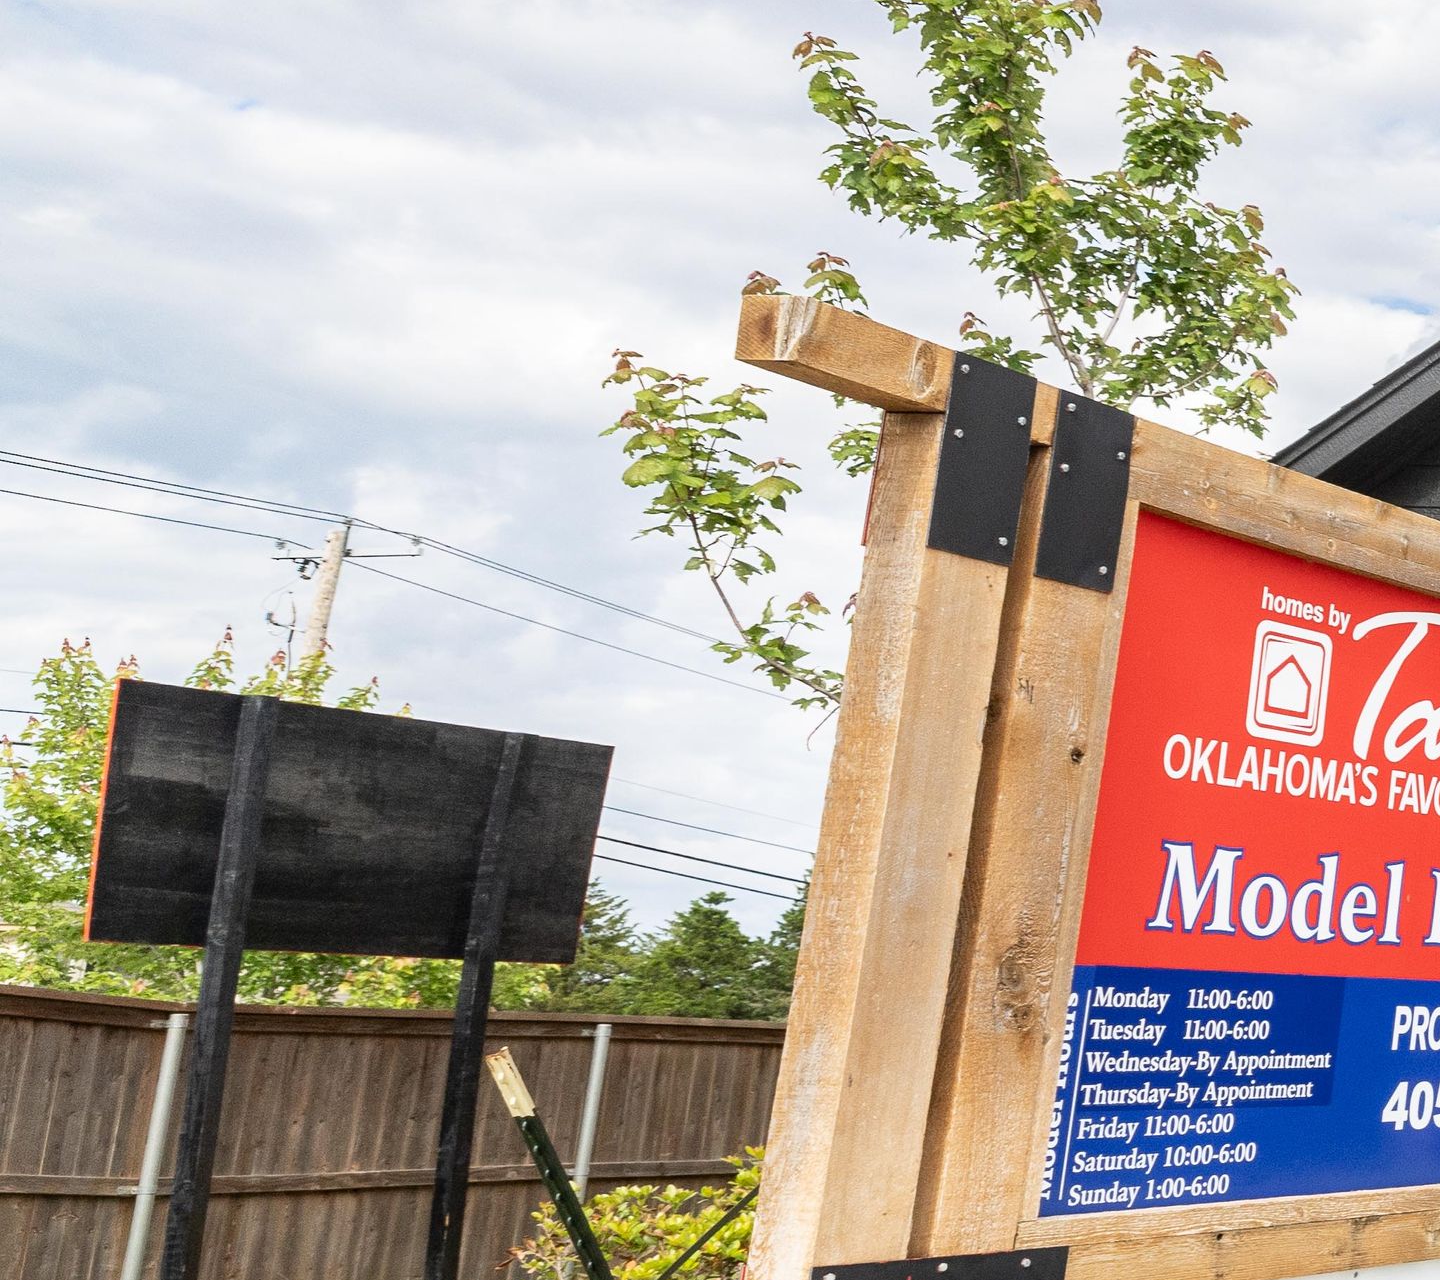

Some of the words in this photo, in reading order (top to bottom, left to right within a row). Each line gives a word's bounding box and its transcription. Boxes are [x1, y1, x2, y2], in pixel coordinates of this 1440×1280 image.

[1261, 586, 1324, 624] homes
[1328, 602, 1351, 634] by
[1163, 733, 1378, 807] OKLAHOMA'S
[1145, 839, 1405, 946] Model
[1092, 986, 1170, 1014] Monday
[1186, 989, 1273, 1010] 11:00-6:00
[1089, 1019, 1166, 1046] Tuesday
[1183, 1020, 1270, 1040] 11:00-6:00
[1085, 1050, 1219, 1077] Wednesday-By
[1223, 1049, 1331, 1076] Appointment
[1080, 1081, 1199, 1109] Thursday-By
[1202, 1080, 1313, 1107] Appointment
[1076, 1117, 1139, 1143] Friday
[1144, 1113, 1234, 1137] 11:00-6:00
[1072, 1148, 1158, 1174] Saturday
[1163, 1142, 1257, 1167] 10:00-6:00
[1068, 1181, 1140, 1208] Sunday
[1145, 1174, 1230, 1200] 1:00-6:00
